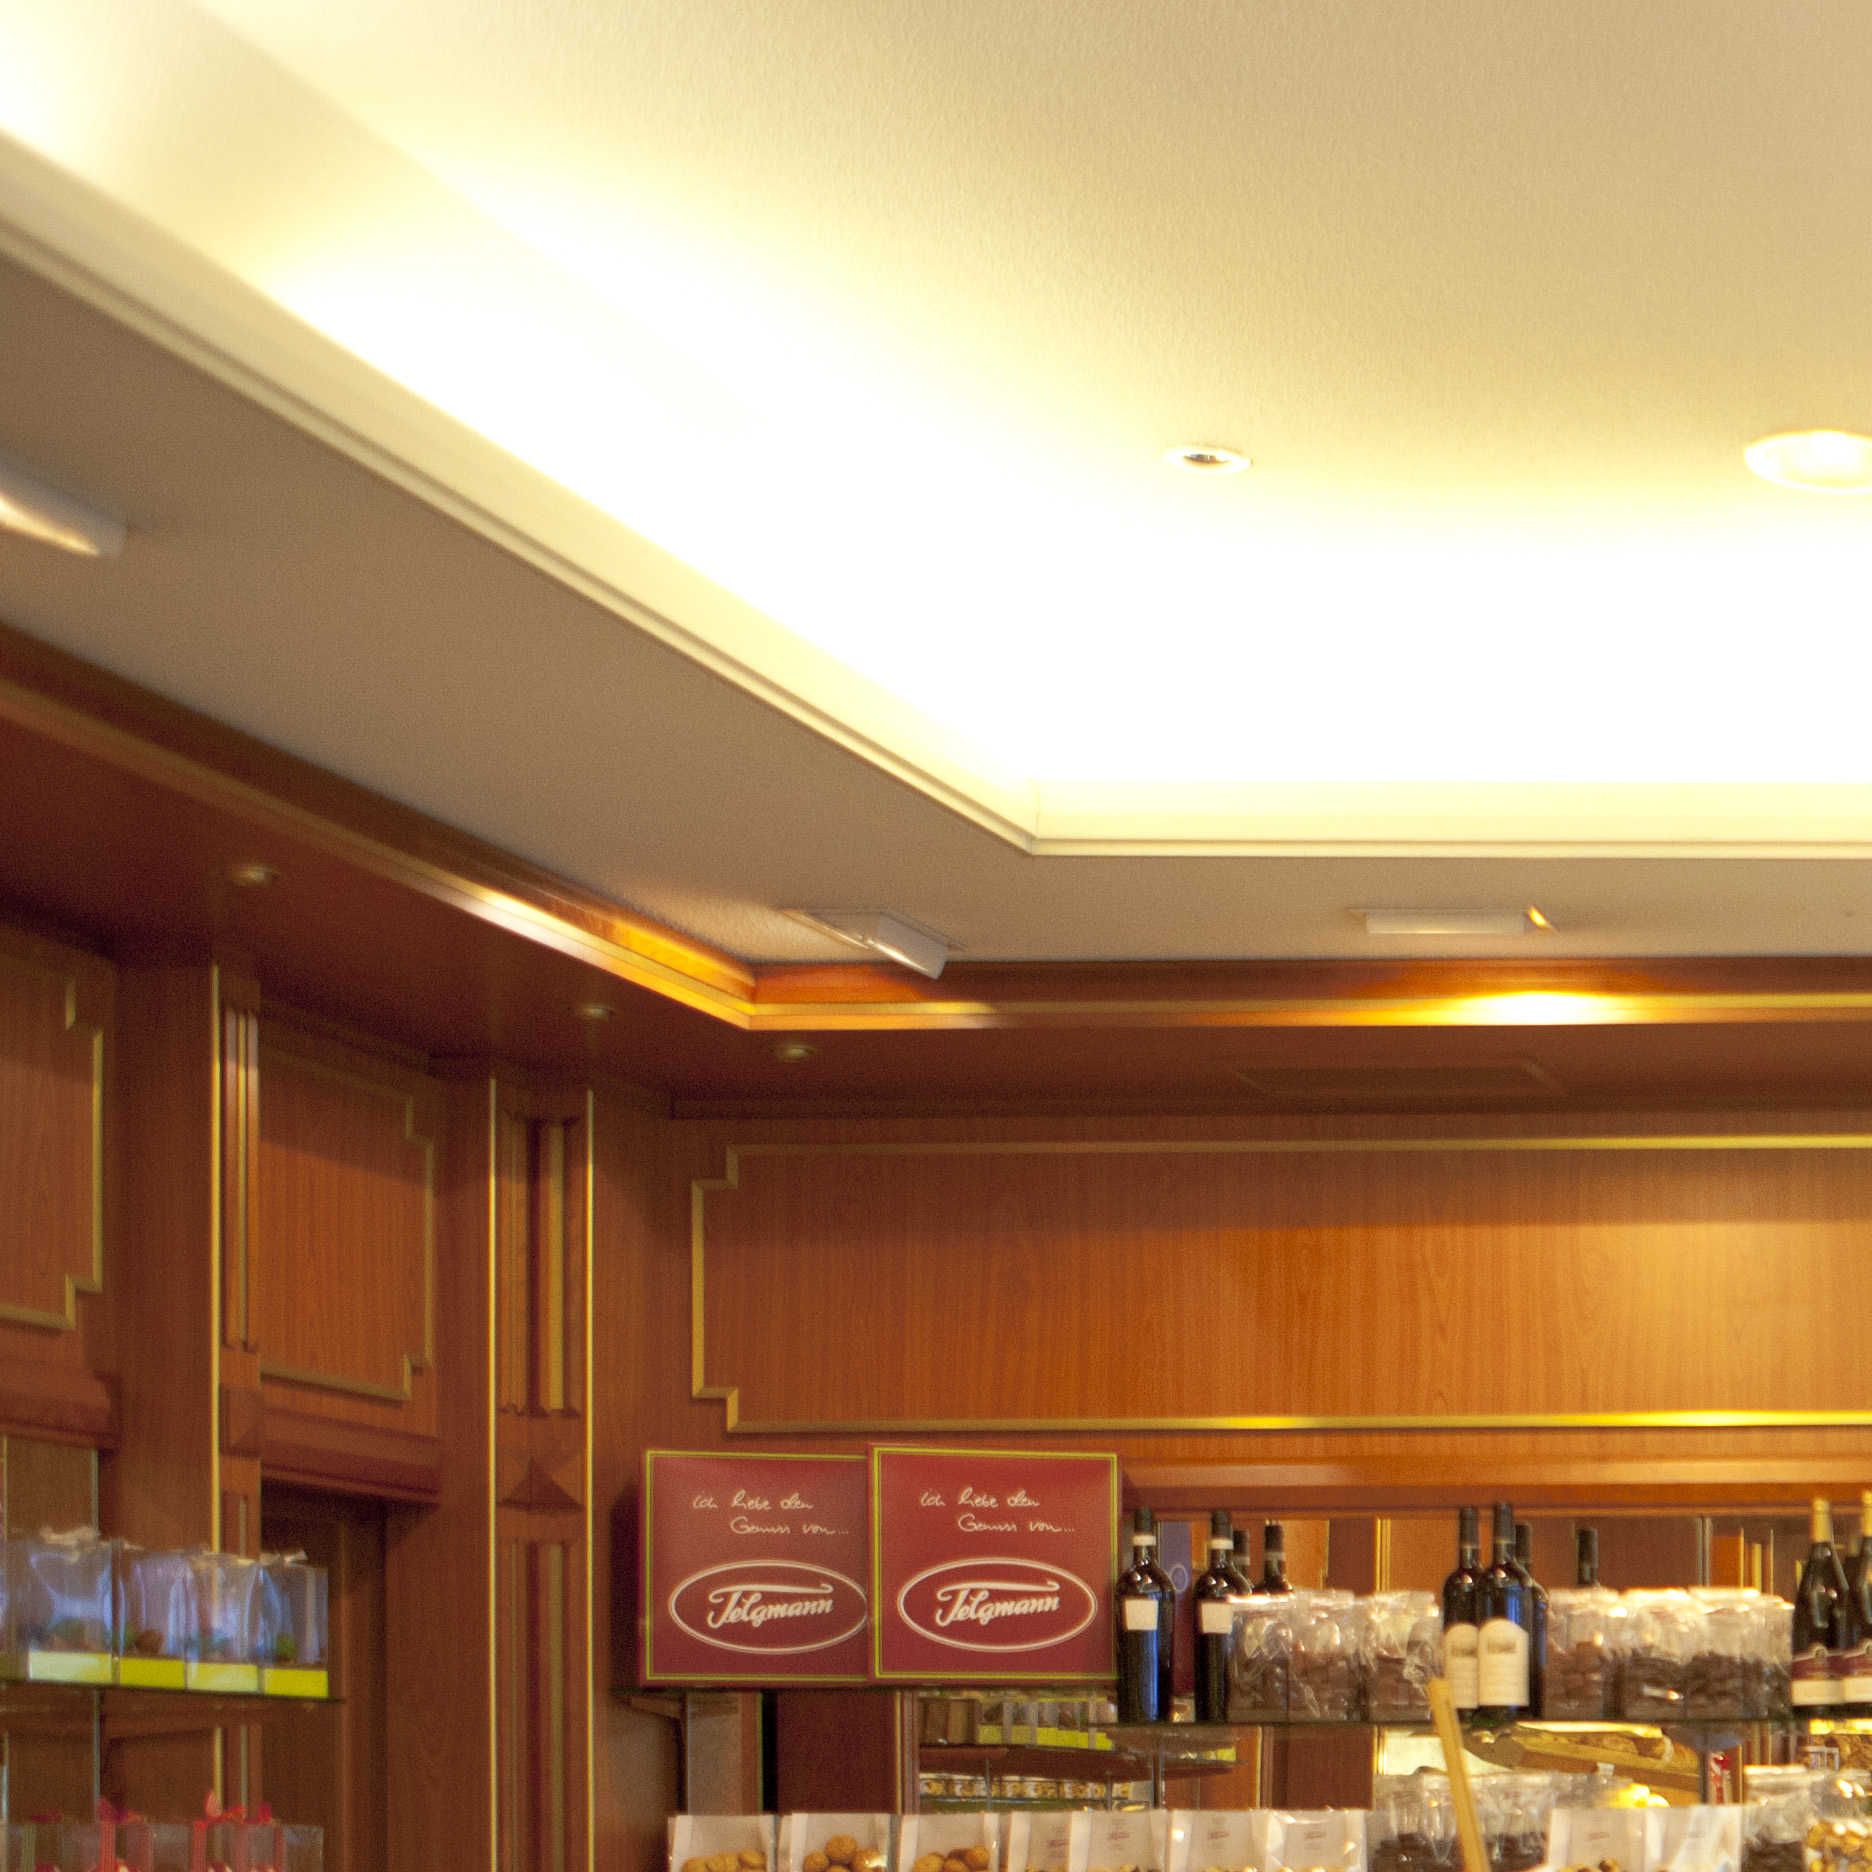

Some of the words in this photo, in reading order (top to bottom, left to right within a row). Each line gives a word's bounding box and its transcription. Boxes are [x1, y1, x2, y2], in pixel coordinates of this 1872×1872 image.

[730, 1489, 772, 1510] liebe
[780, 1492, 814, 1510] den
[958, 1486, 999, 1508] liebe
[1007, 1489, 1041, 1508] den
[730, 1516, 791, 1535] Genuss
[957, 1513, 1018, 1532] Genuss
[707, 1583, 834, 1629] Telgmann
[935, 1577, 1060, 1626] Telgmann
